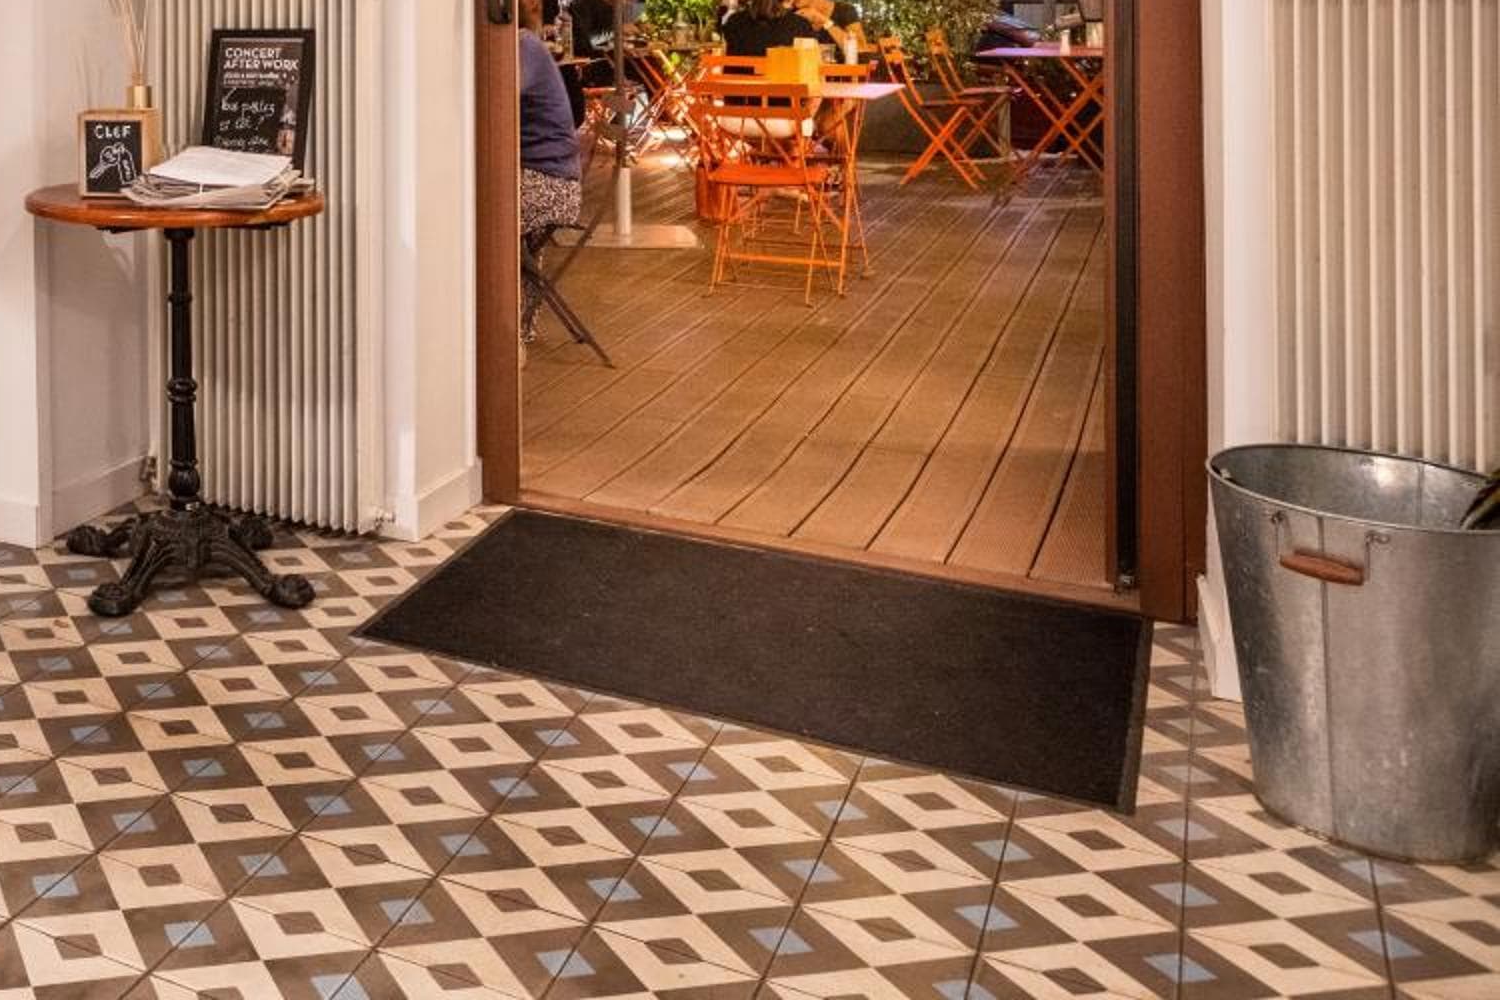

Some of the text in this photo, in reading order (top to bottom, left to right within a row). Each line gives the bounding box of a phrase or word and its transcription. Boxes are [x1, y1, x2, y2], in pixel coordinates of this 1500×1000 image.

[225, 47, 282, 59] CONCERT
[223, 58, 299, 71] AFTER WORK
